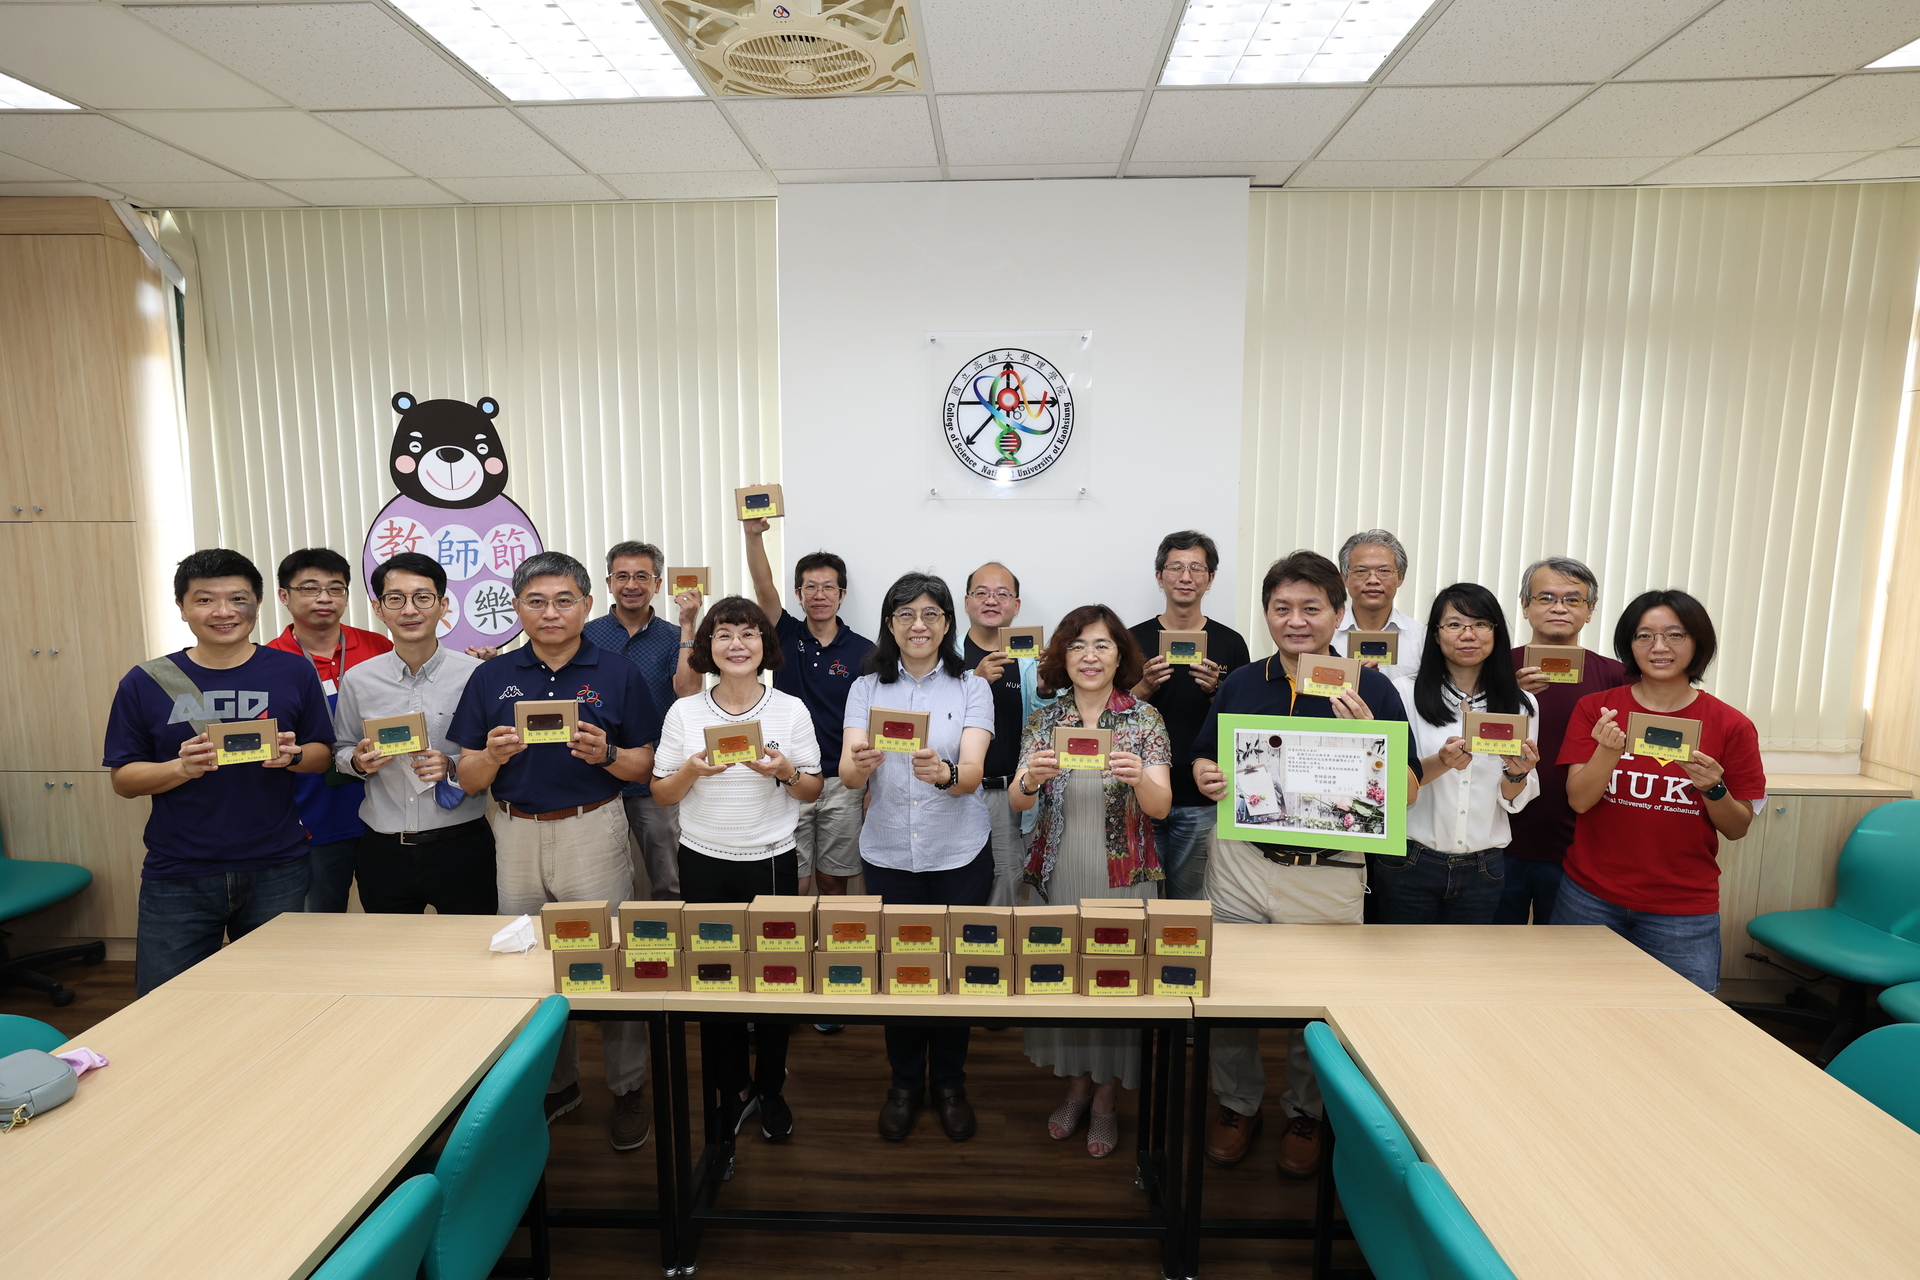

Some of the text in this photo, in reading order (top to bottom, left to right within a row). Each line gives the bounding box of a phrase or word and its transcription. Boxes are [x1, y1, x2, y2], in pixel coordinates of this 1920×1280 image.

[951, 352, 1066, 397] 國立高雄大學理學院
[946, 402, 978, 468] College of Science
[981, 401, 1072, 478] Natil University of Kaohsiung
[375, 519, 526, 579] 教師節
[1618, 798, 1652, 810] University
[1663, 805, 1700, 815] Kaohsiung
